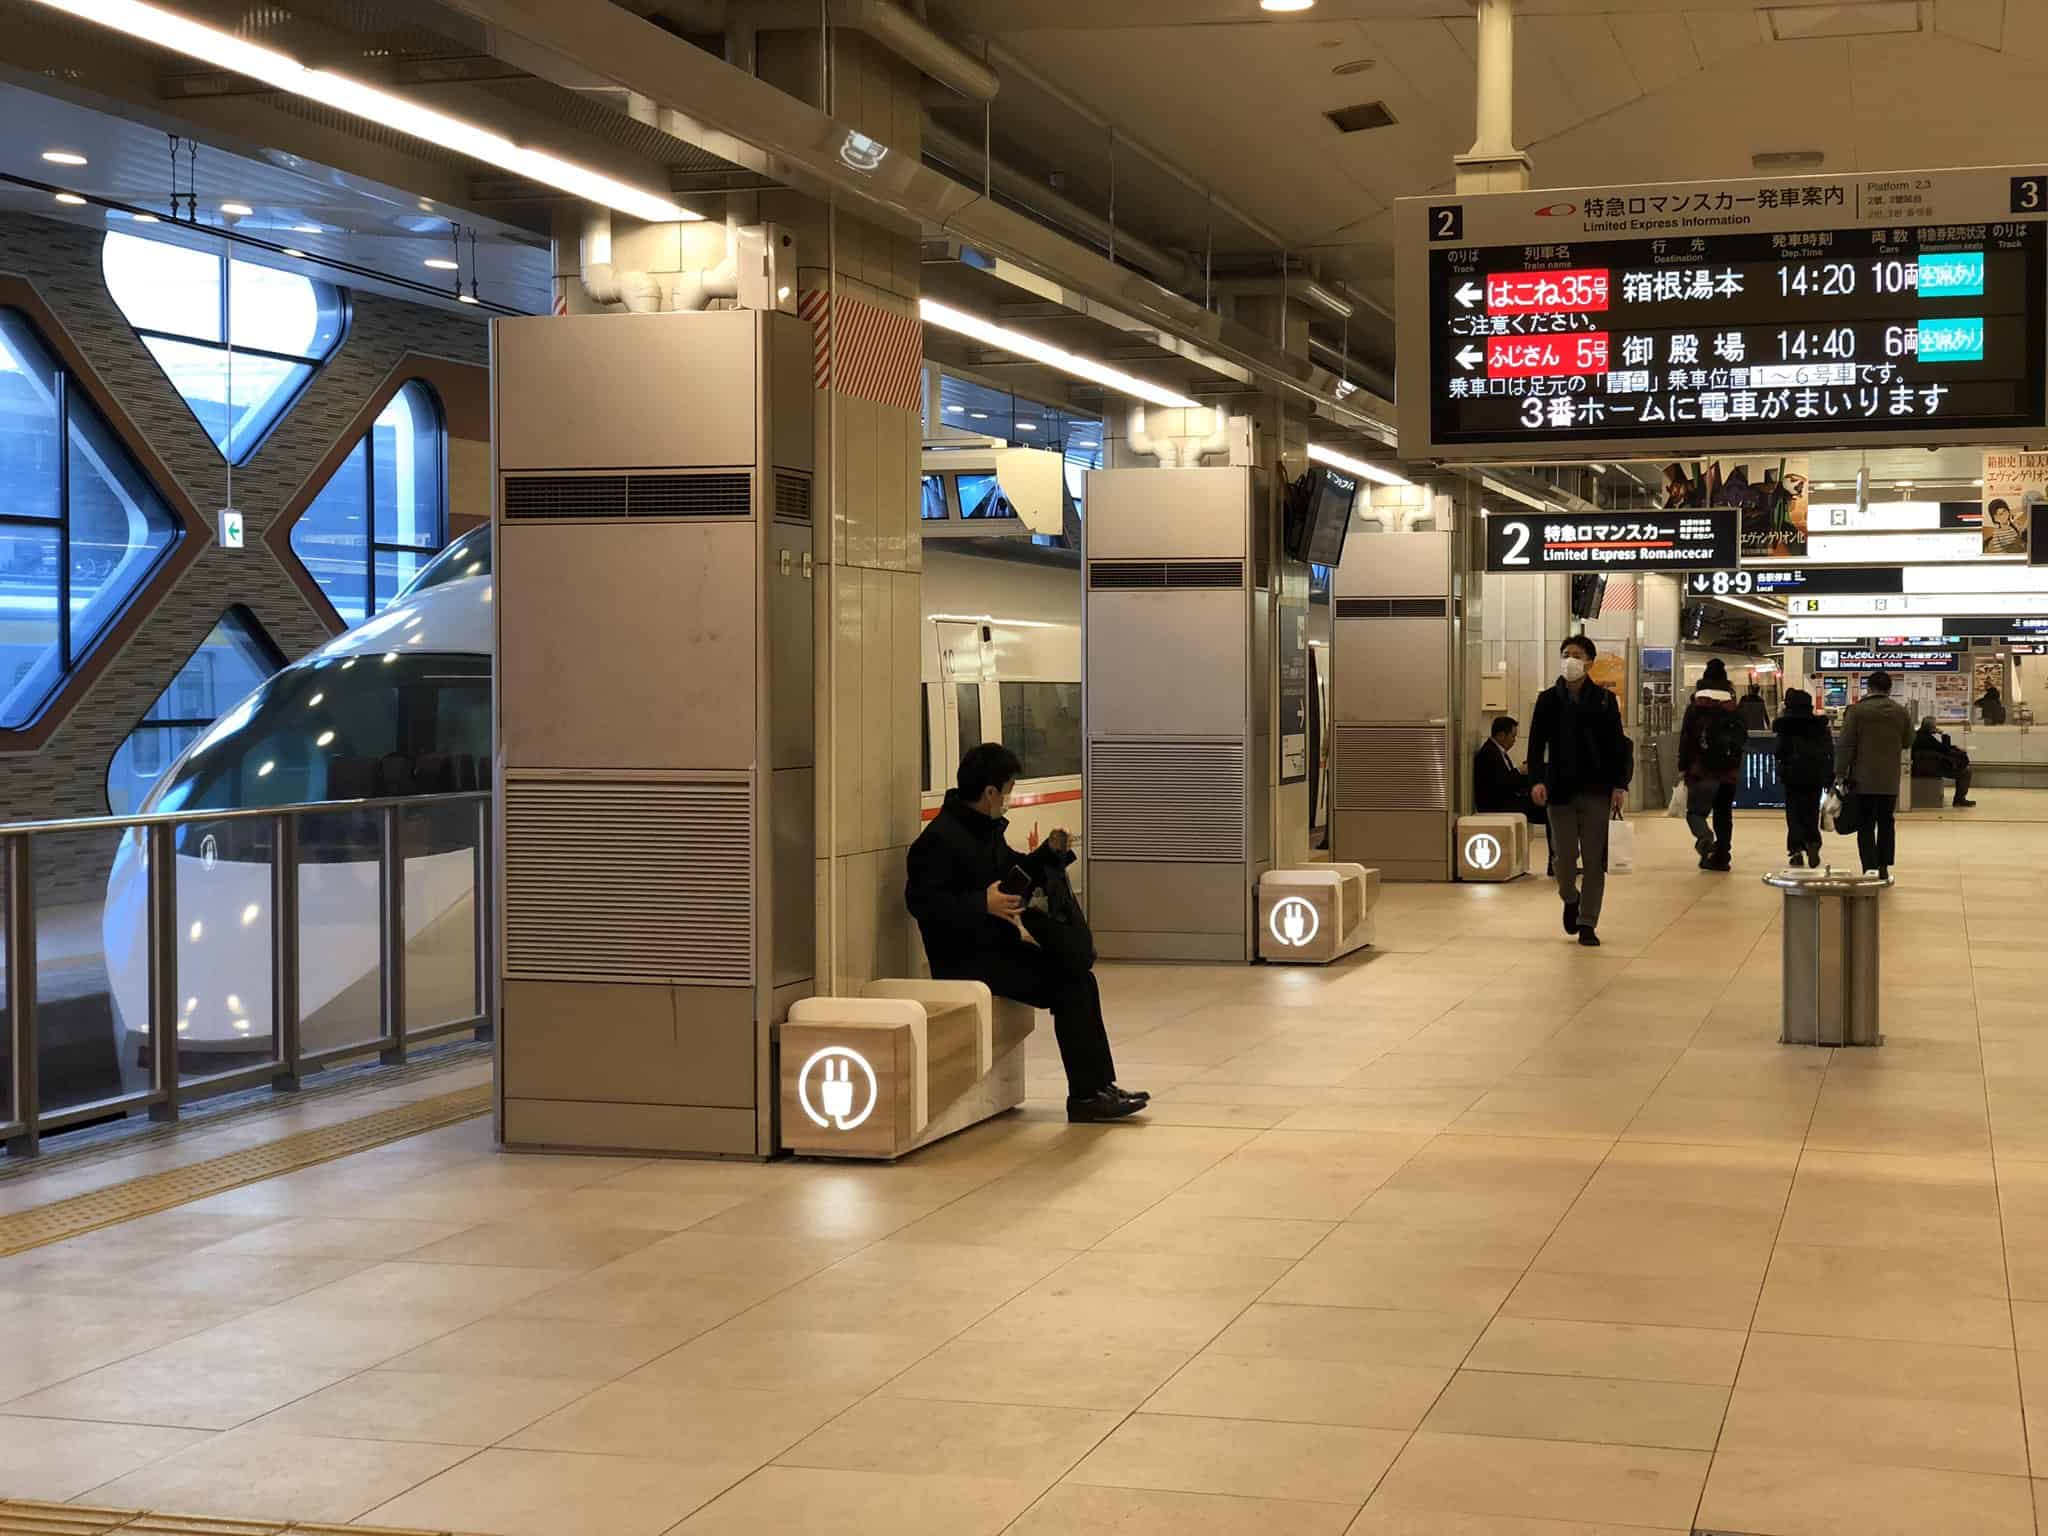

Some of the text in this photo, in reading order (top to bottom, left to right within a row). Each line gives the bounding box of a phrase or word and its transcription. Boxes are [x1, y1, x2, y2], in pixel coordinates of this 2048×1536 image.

[1867, 181, 1909, 192] Platform
[2020, 180, 2039, 208] 3
[1583, 185, 1845, 218] 特急ロマンスカー発車案内
[1437, 211, 1455, 236] 2
[1583, 213, 1751, 232] Limited Express Information
[1992, 223, 2028, 238] のりば
[1772, 231, 1833, 248] 発車時刻
[1998, 240, 2023, 249] Track
[1447, 250, 1480, 264] のりば
[1523, 244, 1571, 261] 列車名
[1653, 253, 1703, 263] Destination
[1879, 245, 1900, 254] Cars
[1453, 265, 1475, 273] Track
[1523, 261, 1572, 270] Train name
[1488, 275, 1608, 308] はこね35号
[1622, 267, 1744, 303] 箱根湯本
[1777, 263, 1856, 298] 14:20
[1871, 261, 1918, 295] 10両
[1451, 312, 1598, 337] ご注意ください。
[1489, 344, 1560, 369] ふじさん
[1777, 327, 1856, 361] 14:40
[1885, 326, 1918, 357] 6両
[1520, 383, 1949, 429] 3番ホームに電車がまいります
[1543, 523, 1675, 543] 特急ロマンスカー
[1502, 522, 1531, 565] 2
[1543, 546, 1715, 563] Limited Express Romancecar
[1776, 627, 1790, 644] 2
